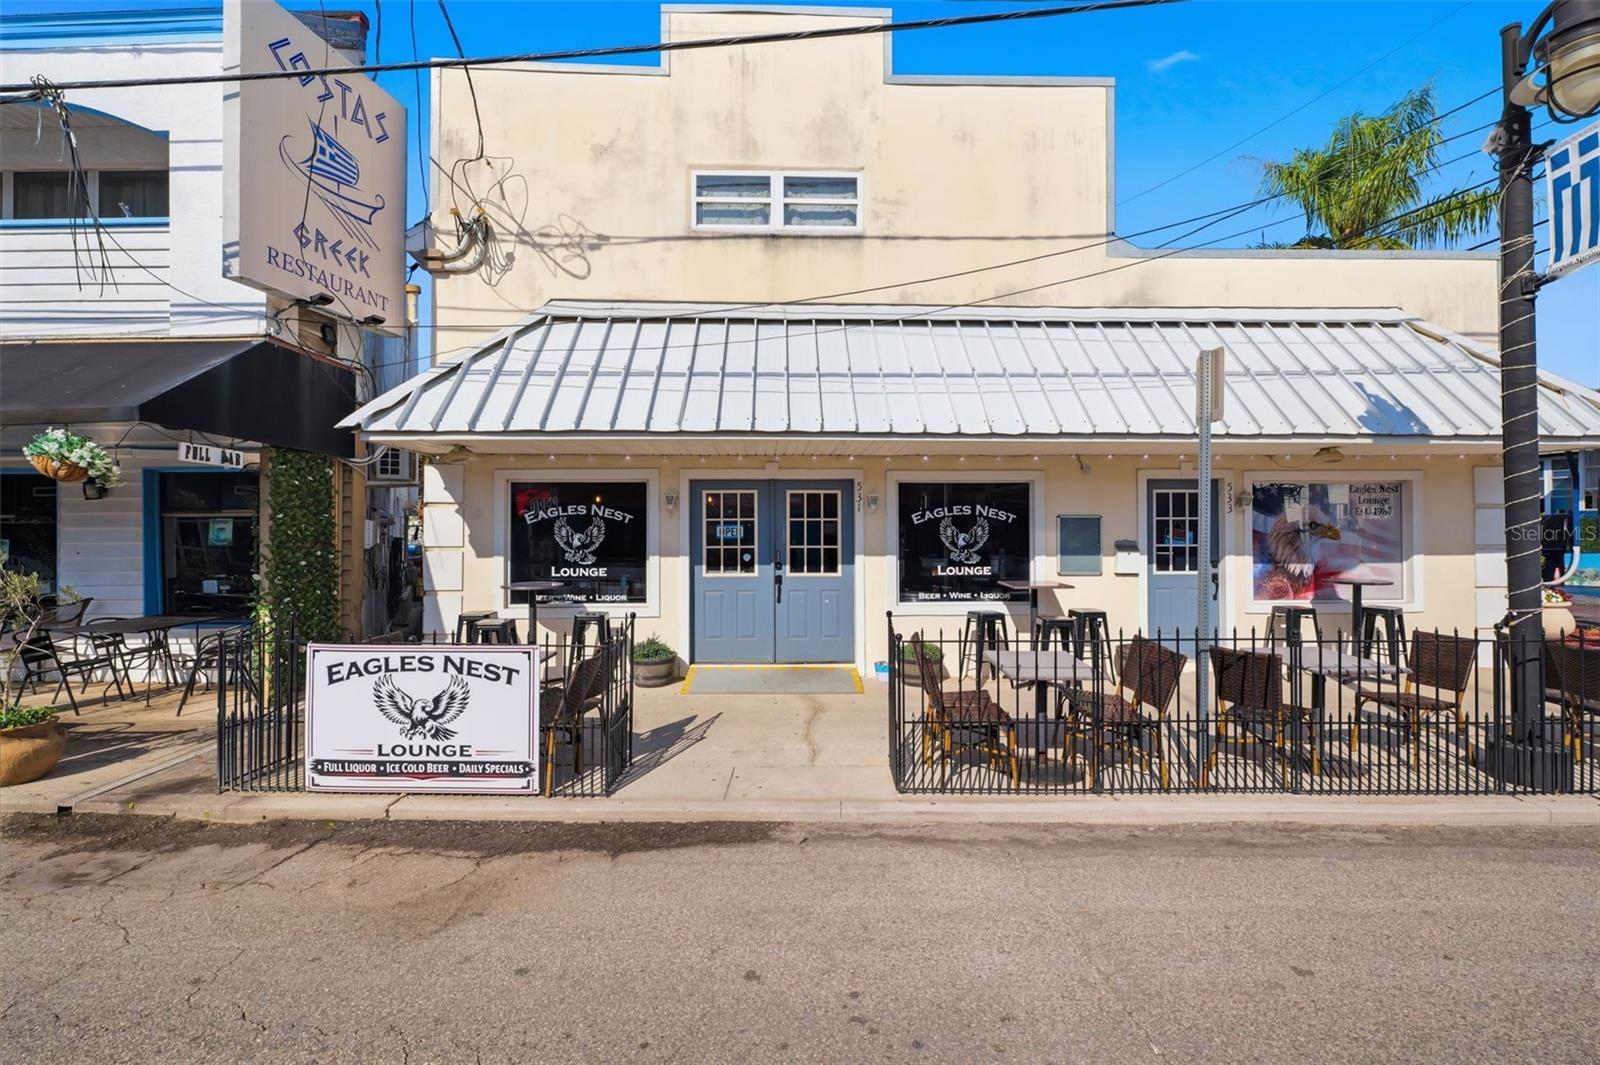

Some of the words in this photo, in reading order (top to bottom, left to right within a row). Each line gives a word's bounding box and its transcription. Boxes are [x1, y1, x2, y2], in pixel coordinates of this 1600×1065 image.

[268, 37, 389, 143] COSTAS
[293, 222, 370, 279] GREEK
[266, 245, 388, 311] RESTAURANT
[1380, 484, 1399, 494] Nest
[1358, 496, 1390, 506] Lounge
[524, 504, 587, 525] EAGLES
[591, 504, 634, 524] NEST
[911, 504, 972, 525] EAGLES
[975, 504, 1017, 524] NEST
[551, 566, 607, 577] LOUNGE
[937, 565, 992, 576] LOUNGE
[595, 594, 627, 602] LIQUOR
[918, 592, 941, 600] BEER
[949, 592, 972, 600] WINE
[980, 592, 1010, 600] LIQUOR
[326, 655, 435, 686] EAGLES
[443, 655, 520, 686] NEST
[377, 744, 472, 758] LOUNGE
[323, 761, 343, 772] FULL
[345, 762, 377, 774] LIQUOR
[386, 763, 400, 773] ICE
[401, 763, 426, 773] COLD
[427, 763, 449, 773] BEER
[459, 764, 486, 774] DAILY
[487, 764, 524, 774] SPECIALS
